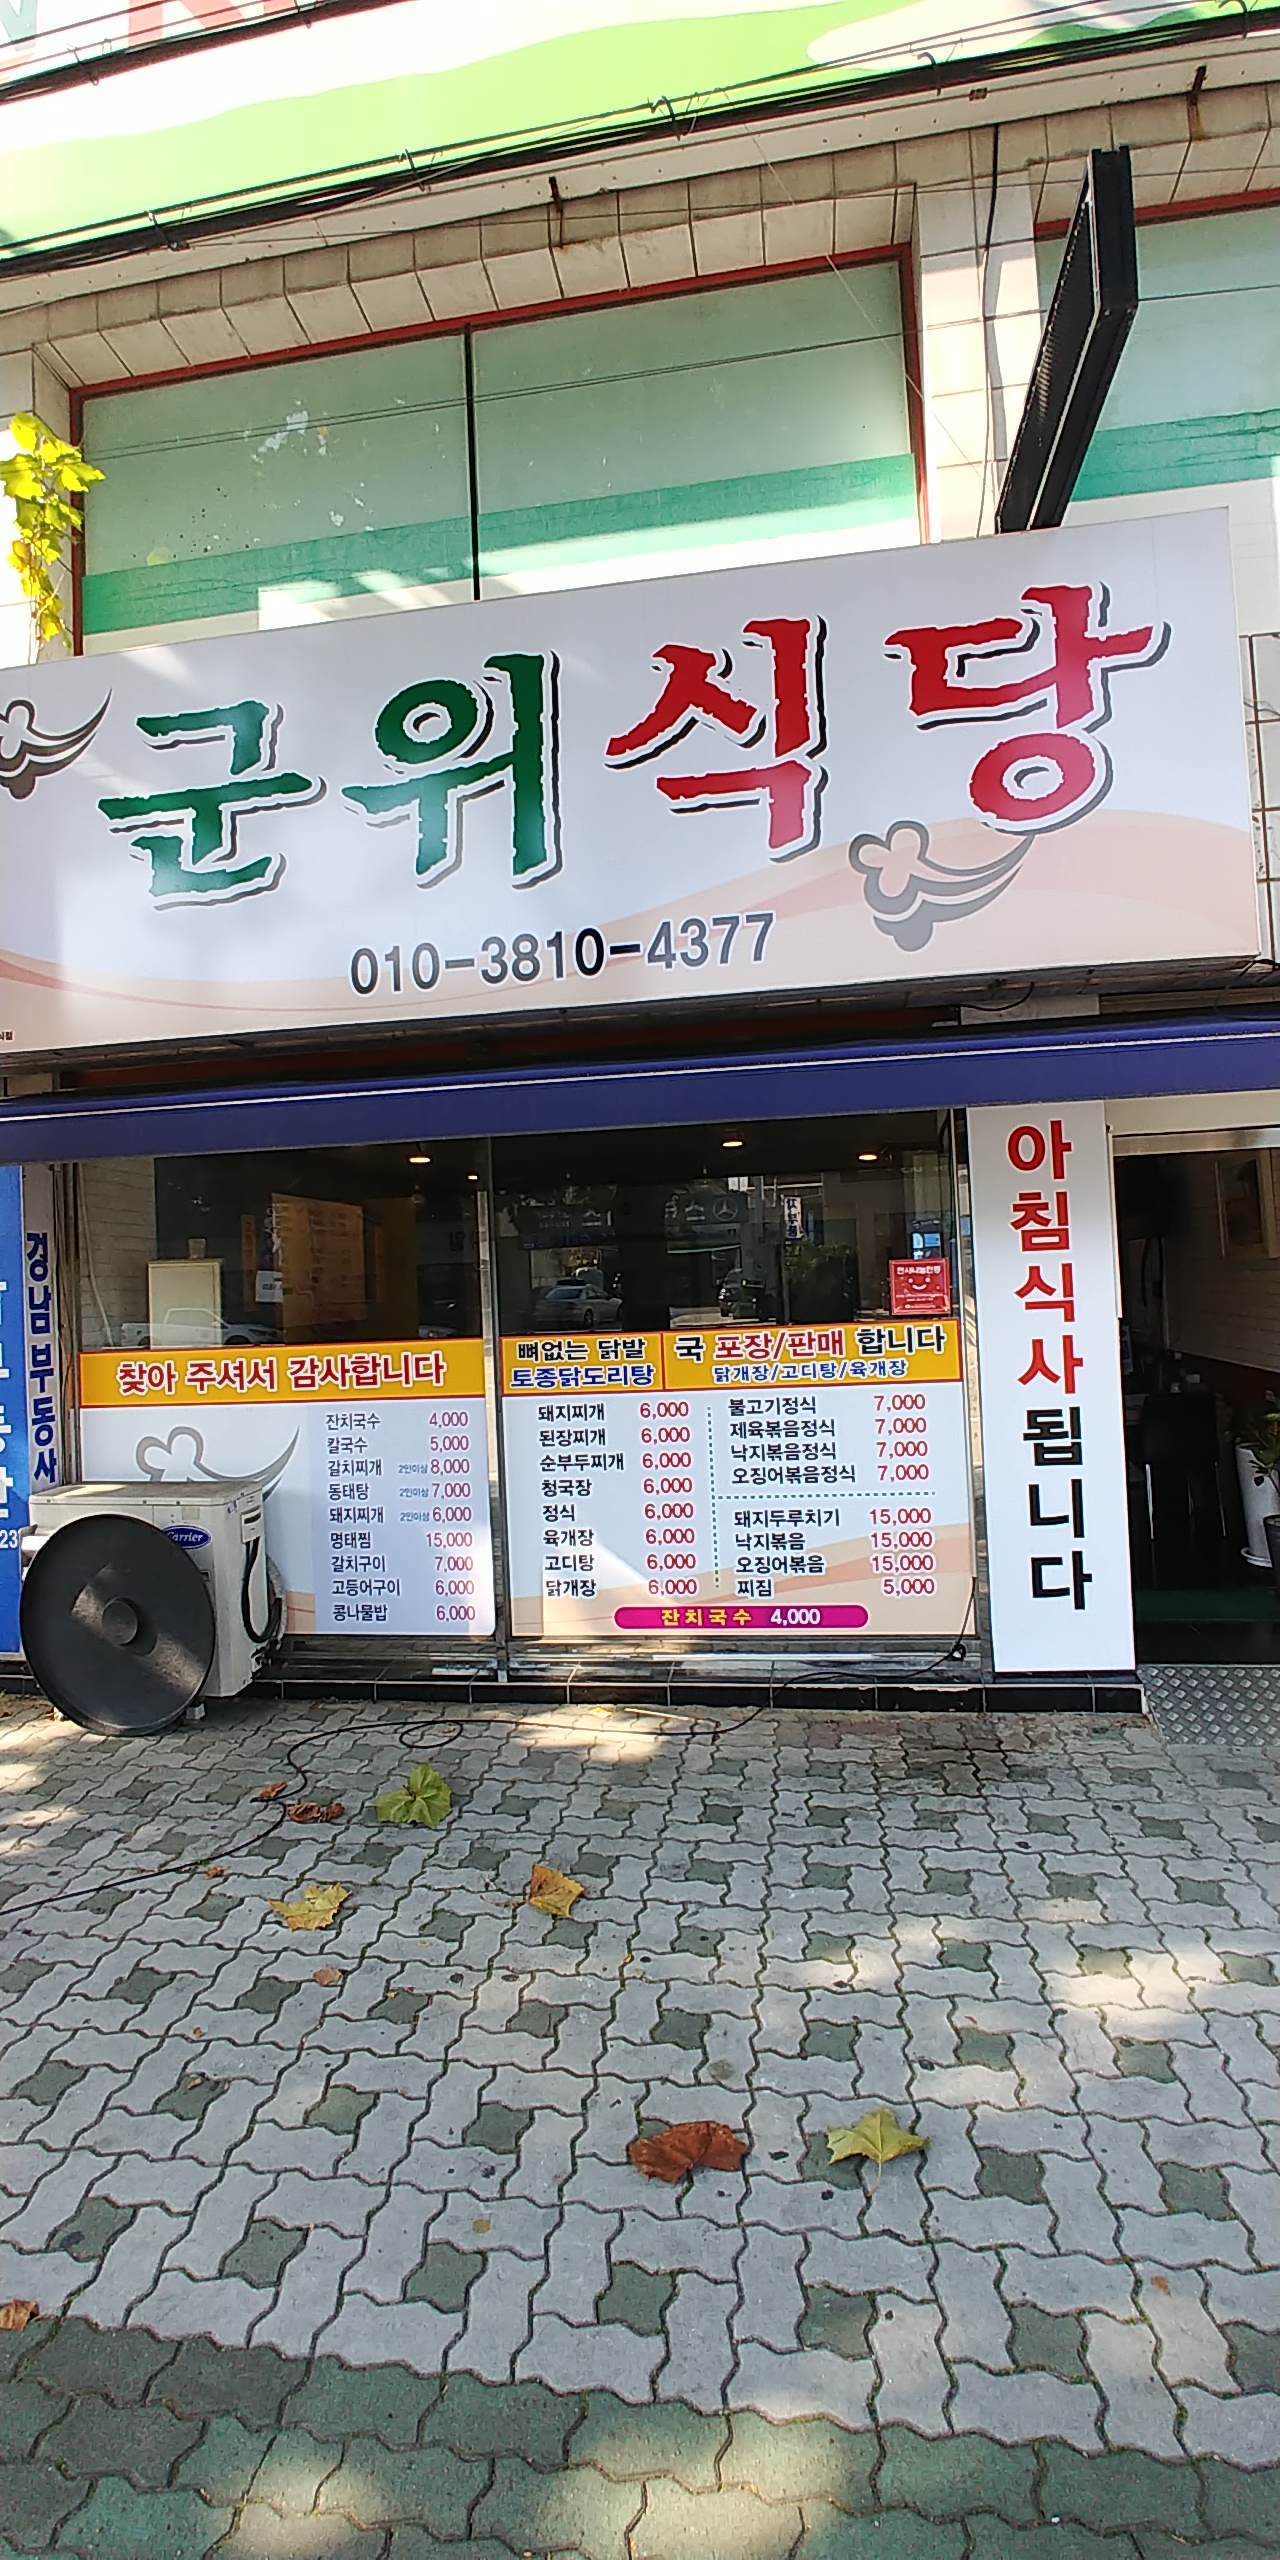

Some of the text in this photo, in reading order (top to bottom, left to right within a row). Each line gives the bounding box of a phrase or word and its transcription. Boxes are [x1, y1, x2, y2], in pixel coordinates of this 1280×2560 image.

[350, 911, 775, 996] 010-3810-4377
[516, 1338, 646, 1363] 뼈없는 닭발
[675, 1326, 946, 1361] 국 포장/판매 합니다
[117, 1352, 445, 1395] 찾아 주셔서 감사합니다
[510, 1363, 655, 1389] 토종닭도리탕
[712, 1359, 909, 1384] 닭개장/고디탕/육개장
[538, 1401, 689, 1423] 돼지찌개 6,000
[728, 1394, 926, 1417] 불고기정식 7,000
[325, 1411, 469, 1431] 잔치국수 4,000
[729, 1417, 928, 1440] 제육볶음정식 7,000
[327, 1435, 470, 1454] 칼국수 5,000
[539, 1427, 691, 1447] 된장찌개 6,000
[730, 1440, 929, 1462] 낙지볶음정식 7,000
[328, 1458, 470, 1477] 갈치찌개 2인이상 8,000
[539, 1452, 692, 1473] 순부두찌개 6,000
[731, 1463, 930, 1485] 오징어볶음정식 7,000
[328, 1482, 471, 1501] 동태탕 2인이상 7,000
[541, 1477, 693, 1498] 청국장 6,000
[329, 1506, 472, 1524] 돼지찌개 2인이상 6,000
[542, 1502, 694, 1523] 정식 6,000
[733, 1508, 932, 1529] 돼지두루치기 15,000
[330, 1531, 473, 1550] 명태찜 15,000
[543, 1528, 695, 1547] 육개장 6,000
[735, 1531, 934, 1552] 낙지볶음 15,000
[331, 1555, 474, 1573] 갈치구이 7,000
[544, 1553, 697, 1572] 고디탕 6,000
[735, 1555, 935, 1575] 오징어볶음 15,000
[332, 1578, 475, 1597] 고등어구이 6,000
[545, 1578, 698, 1597] 닭개장 6,000
[736, 1578, 936, 1598] 찌짐 5,000
[333, 1603, 476, 1622] 콩나물밥 6,000
[770, 1608, 821, 1627] 4,000
